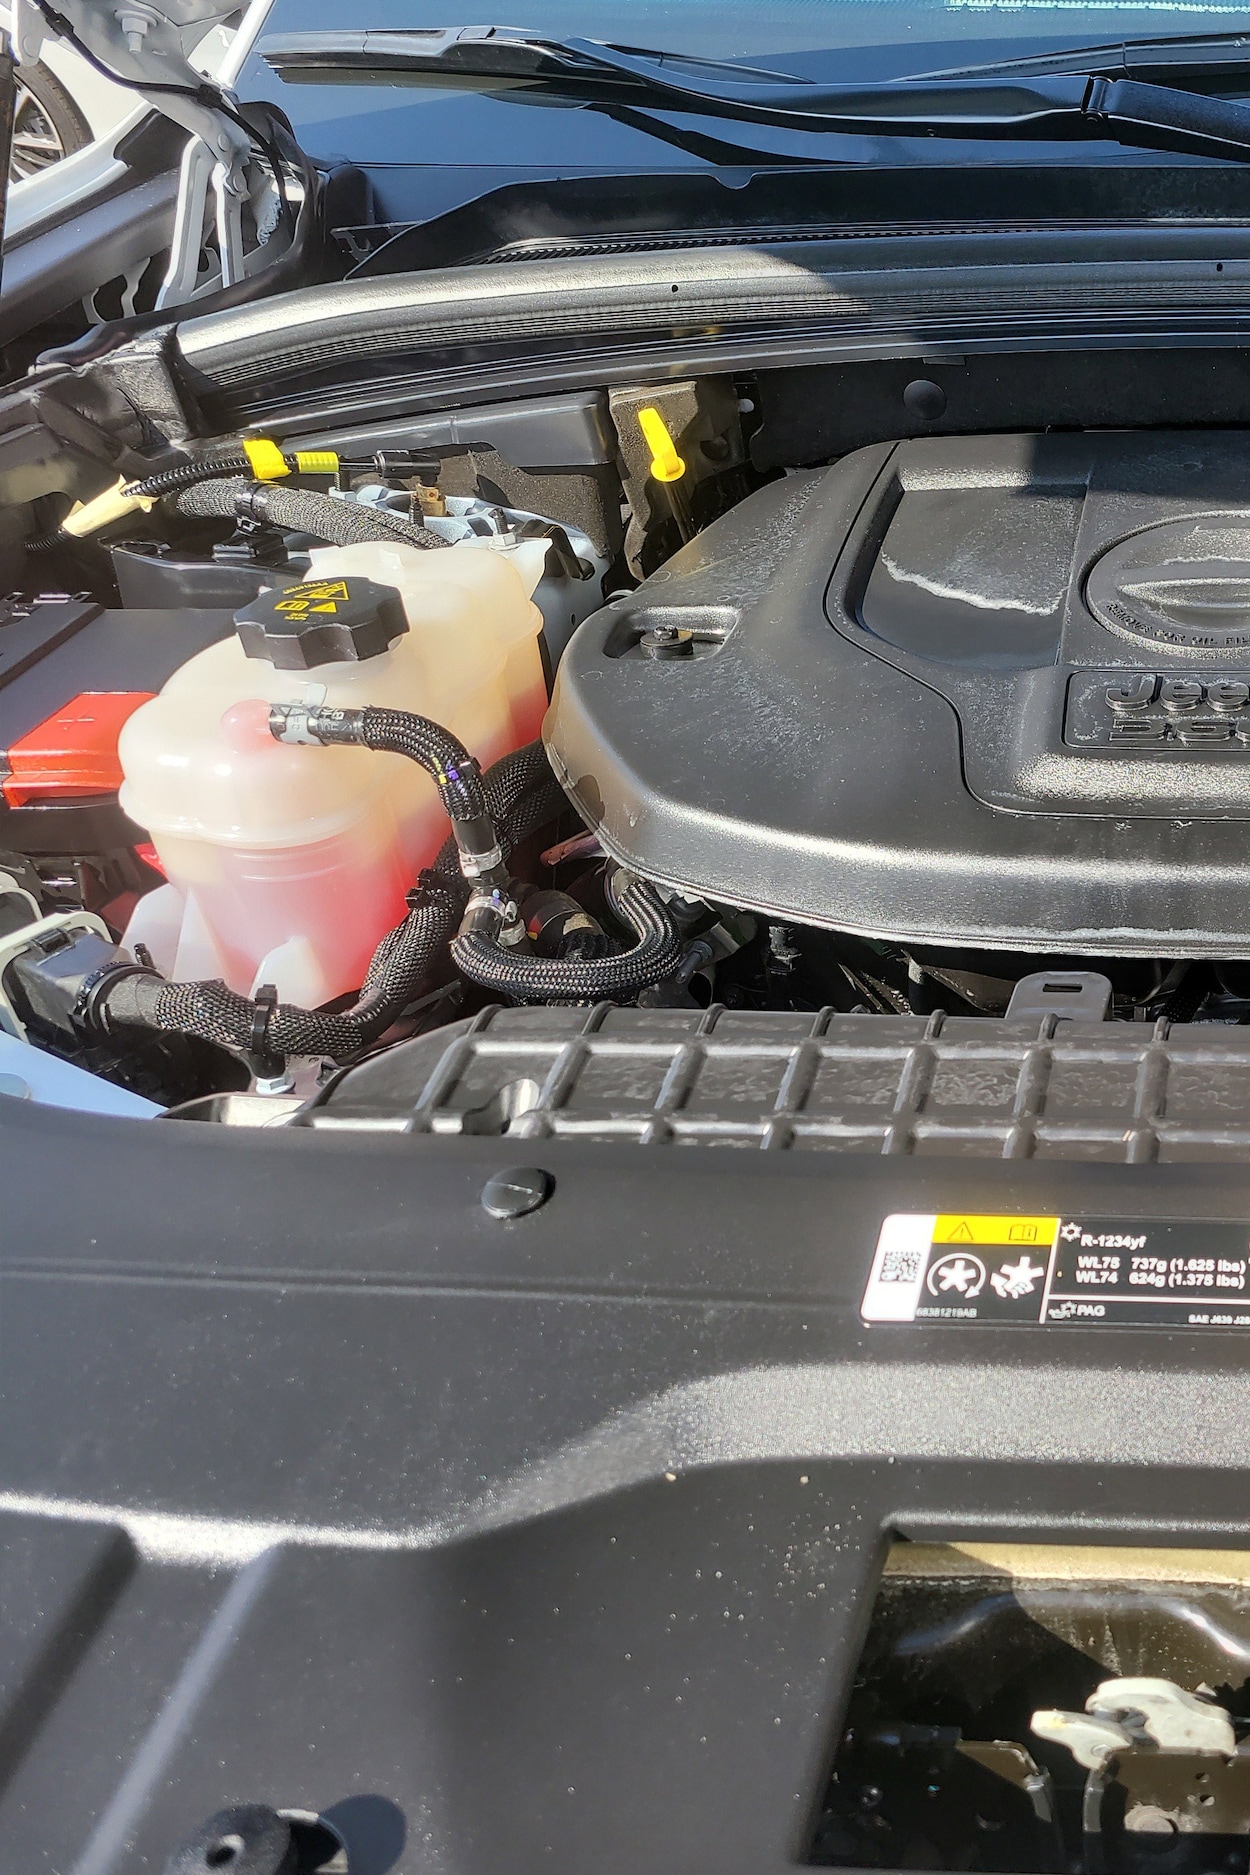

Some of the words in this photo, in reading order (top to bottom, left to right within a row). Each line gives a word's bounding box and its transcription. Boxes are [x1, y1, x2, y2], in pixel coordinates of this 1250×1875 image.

[1191, 636, 1217, 645] OIL
[1080, 1234, 1147, 1250] R-1234yf
[1078, 1256, 1120, 1270] WL75
[1131, 1257, 1167, 1273] 737g
[1170, 1258, 1215, 1273] (1.625
[1217, 1260, 1246, 1275] lbs)
[1076, 1271, 1119, 1284] WL74
[1128, 1272, 1166, 1287] 624g
[1168, 1273, 1214, 1288] (1.375
[1216, 1274, 1245, 1290] lbs)
[1077, 1304, 1105, 1317] PAG
